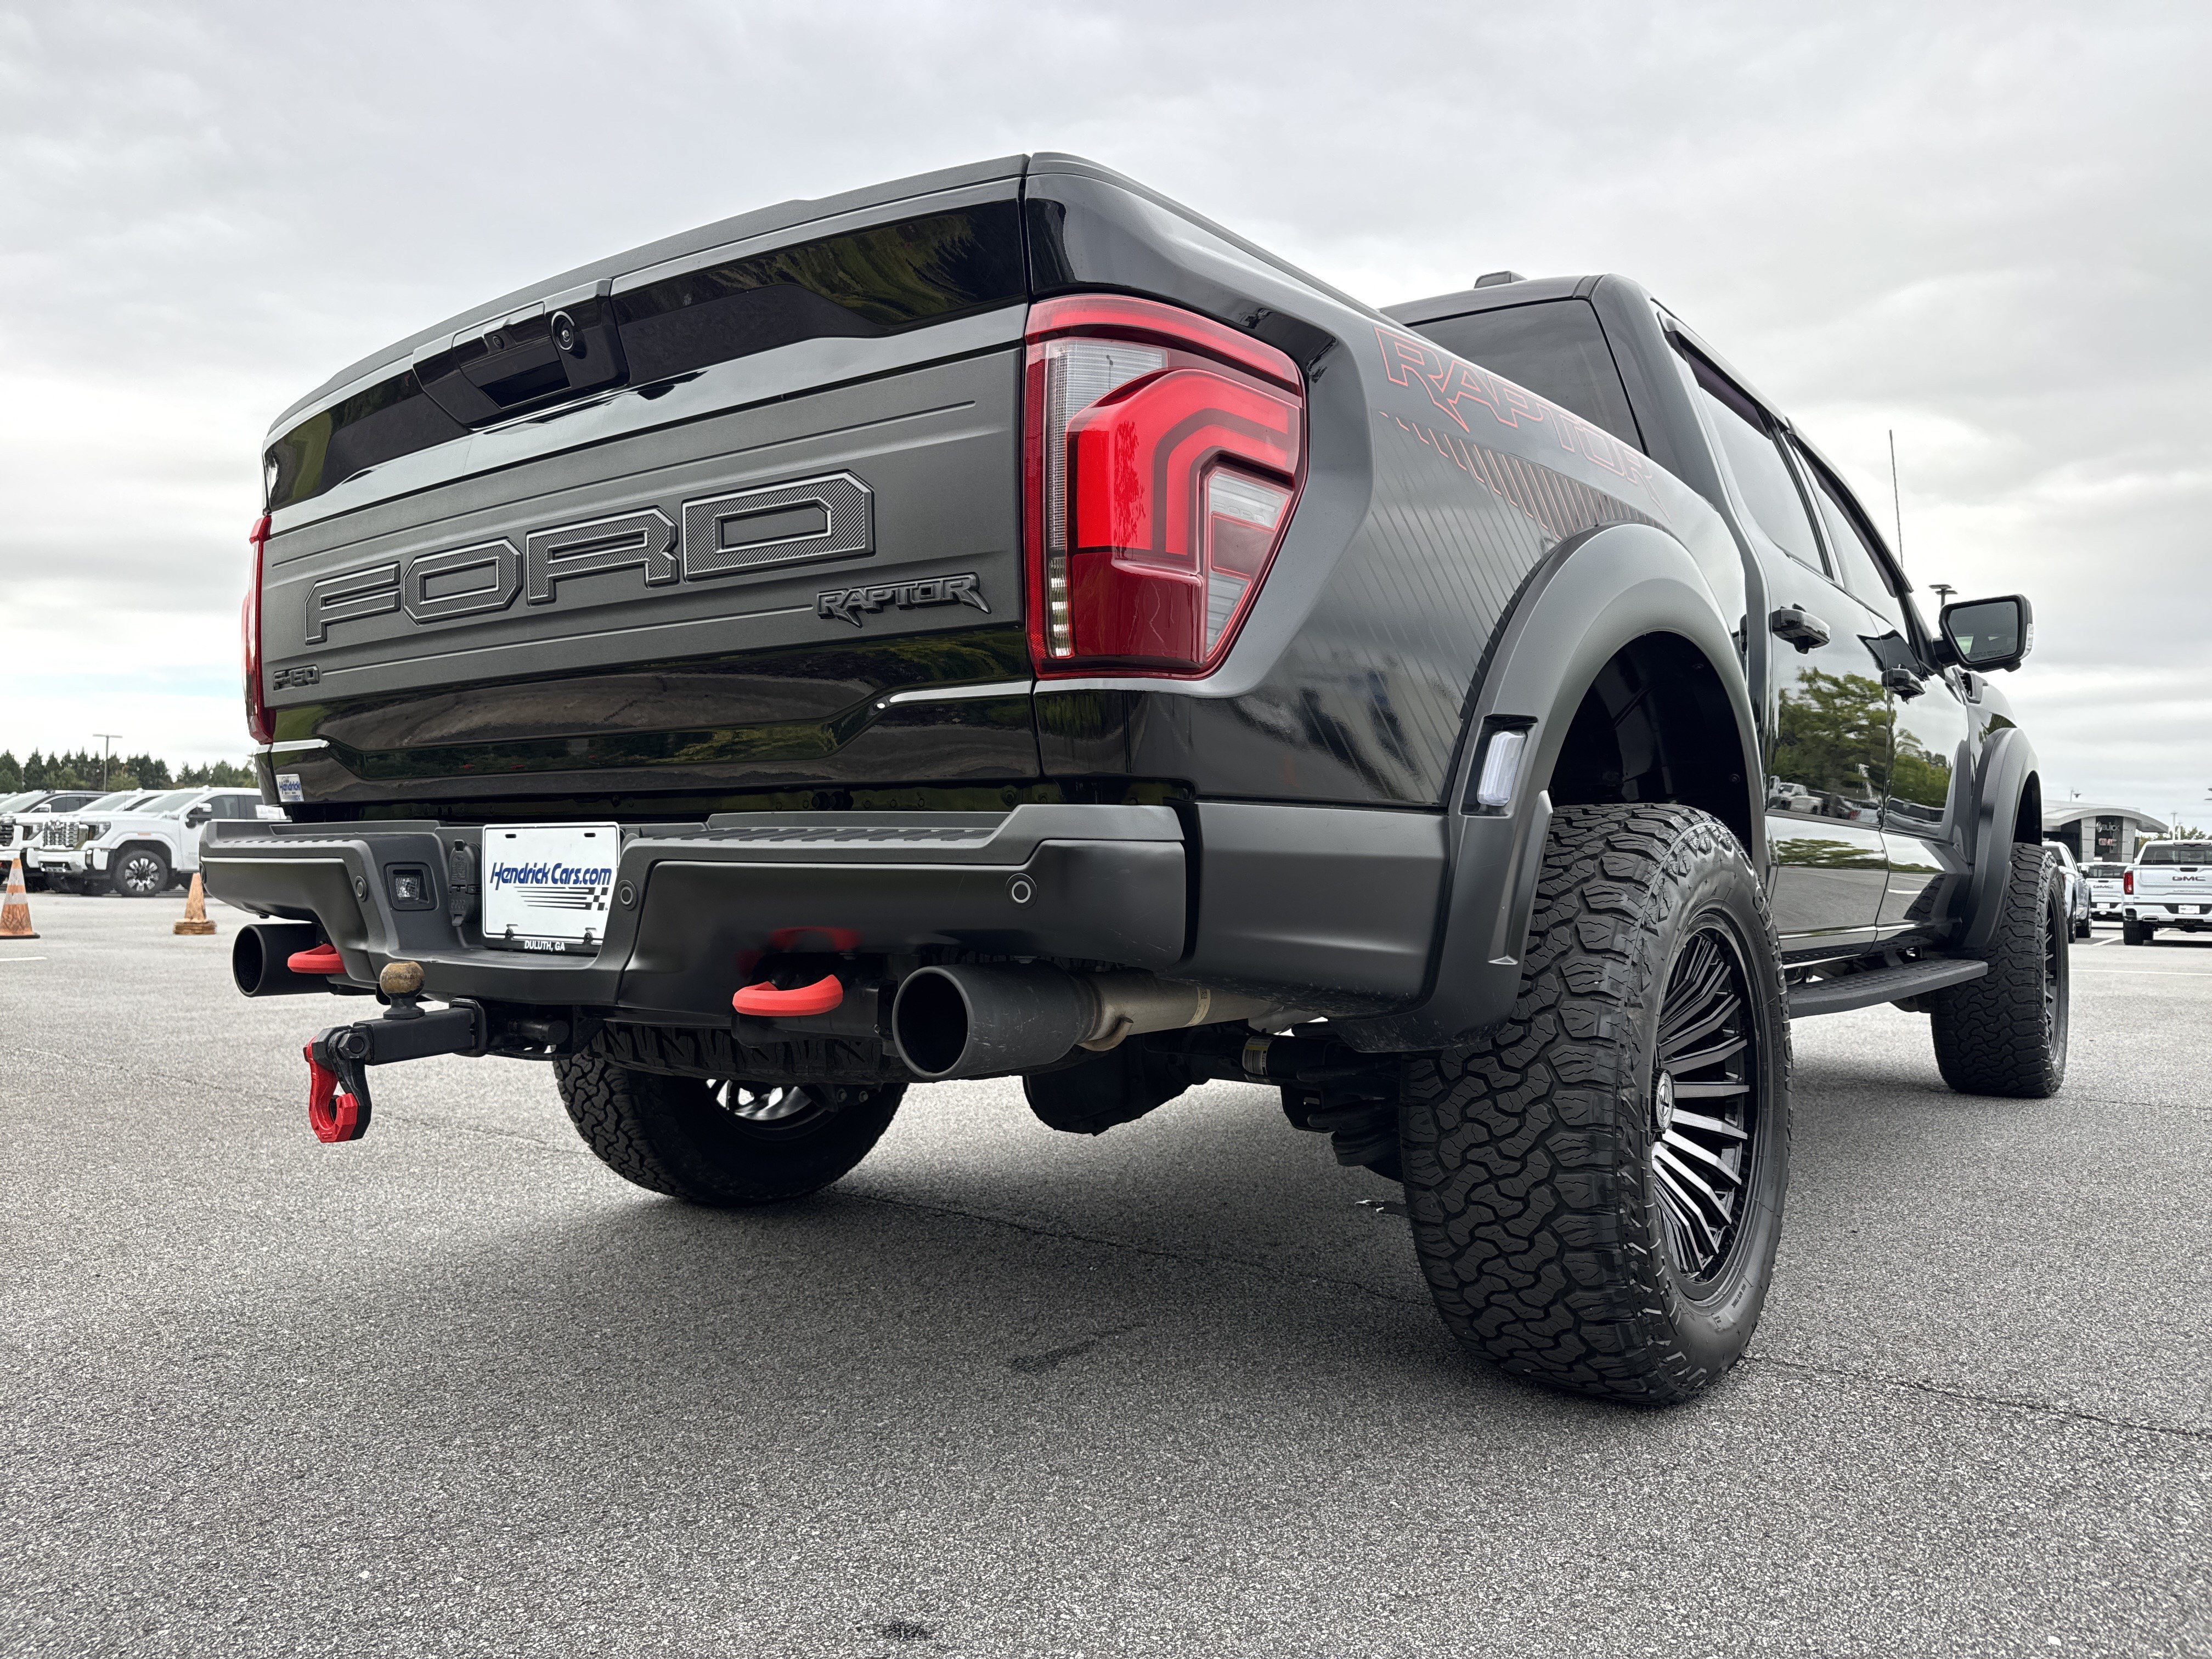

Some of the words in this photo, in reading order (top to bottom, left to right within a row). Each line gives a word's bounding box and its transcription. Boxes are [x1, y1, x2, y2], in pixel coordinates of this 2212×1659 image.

[1374, 326, 1672, 523] RAPTOR
[304, 470, 875, 646] FORD
[817, 573, 991, 629] RAPTOR
[524, 940, 553, 952] DULUTH,
